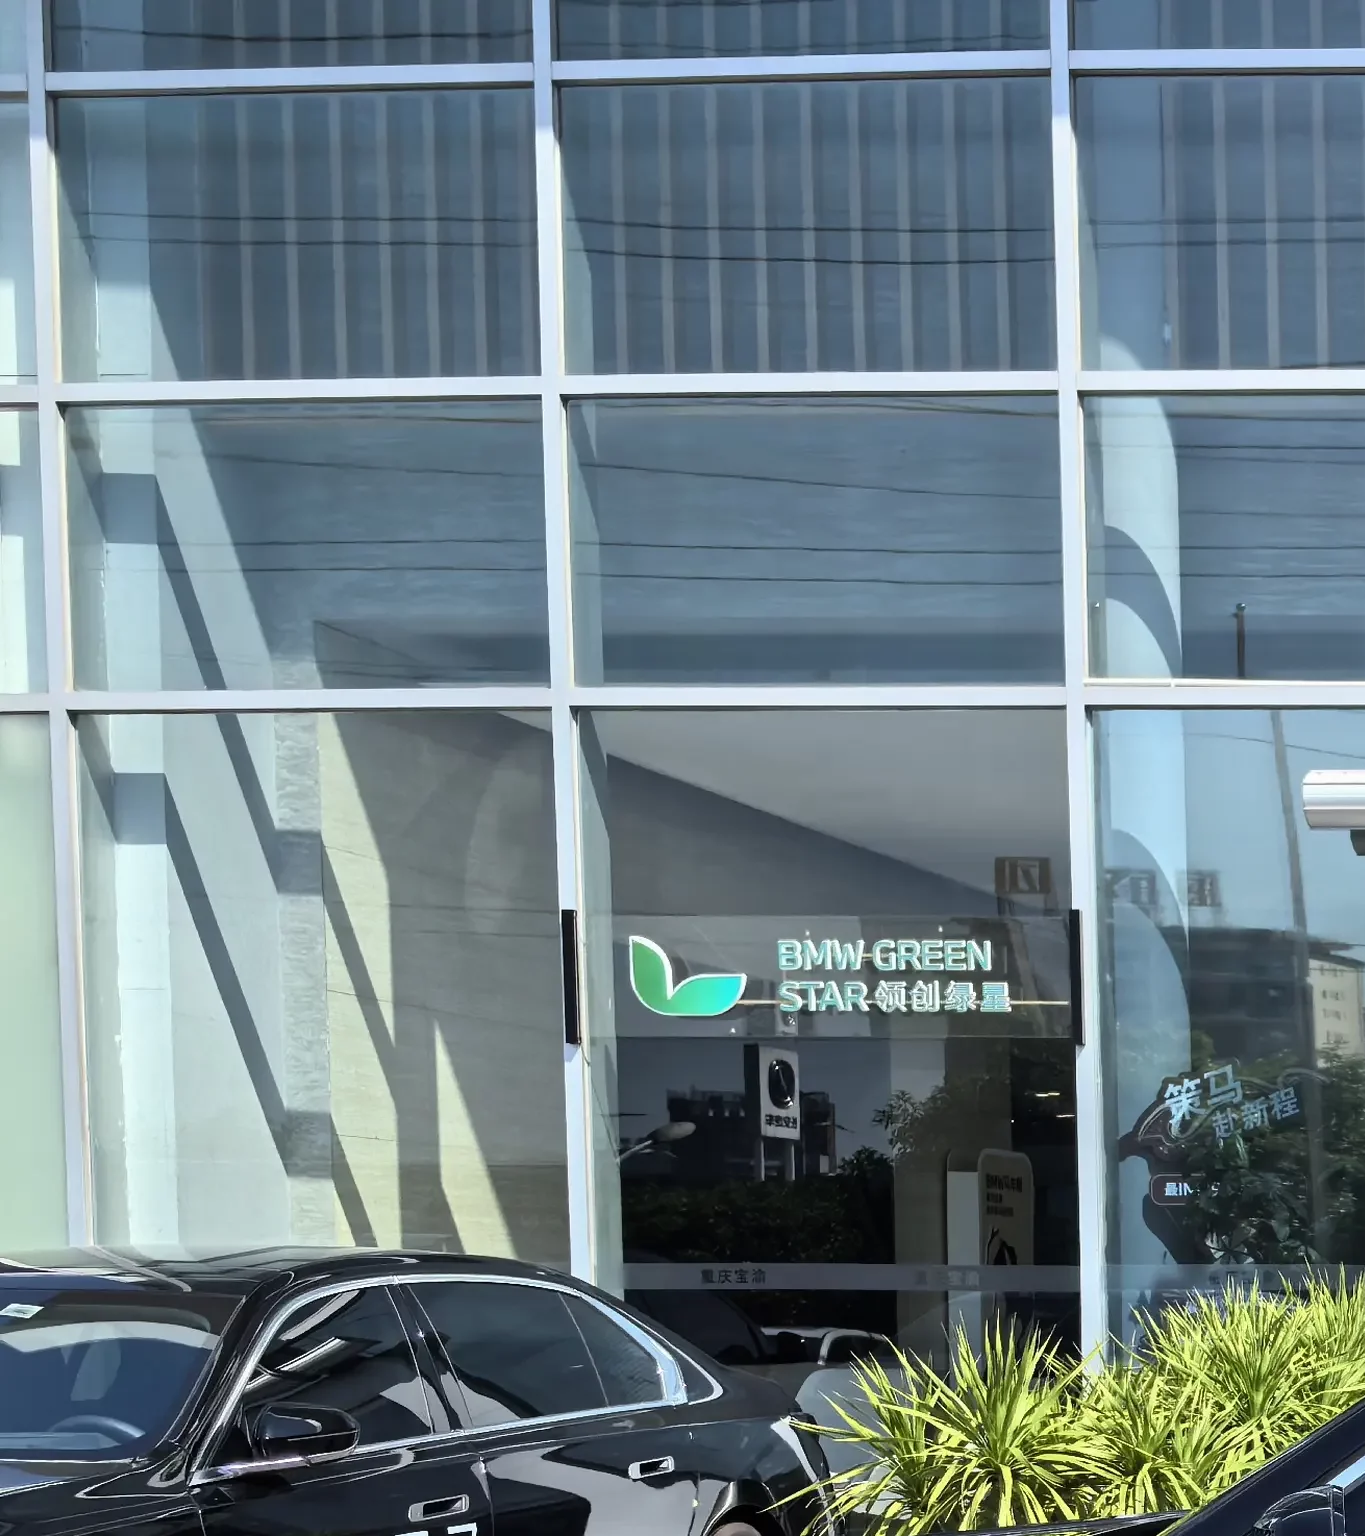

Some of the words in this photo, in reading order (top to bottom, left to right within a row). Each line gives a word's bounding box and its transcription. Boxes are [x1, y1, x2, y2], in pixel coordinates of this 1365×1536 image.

[777, 939, 865, 971] BMW
[872, 939, 993, 971] GREEN
[778, 980, 870, 1012] STAR
[874, 979, 1013, 1013] 领创绿星
